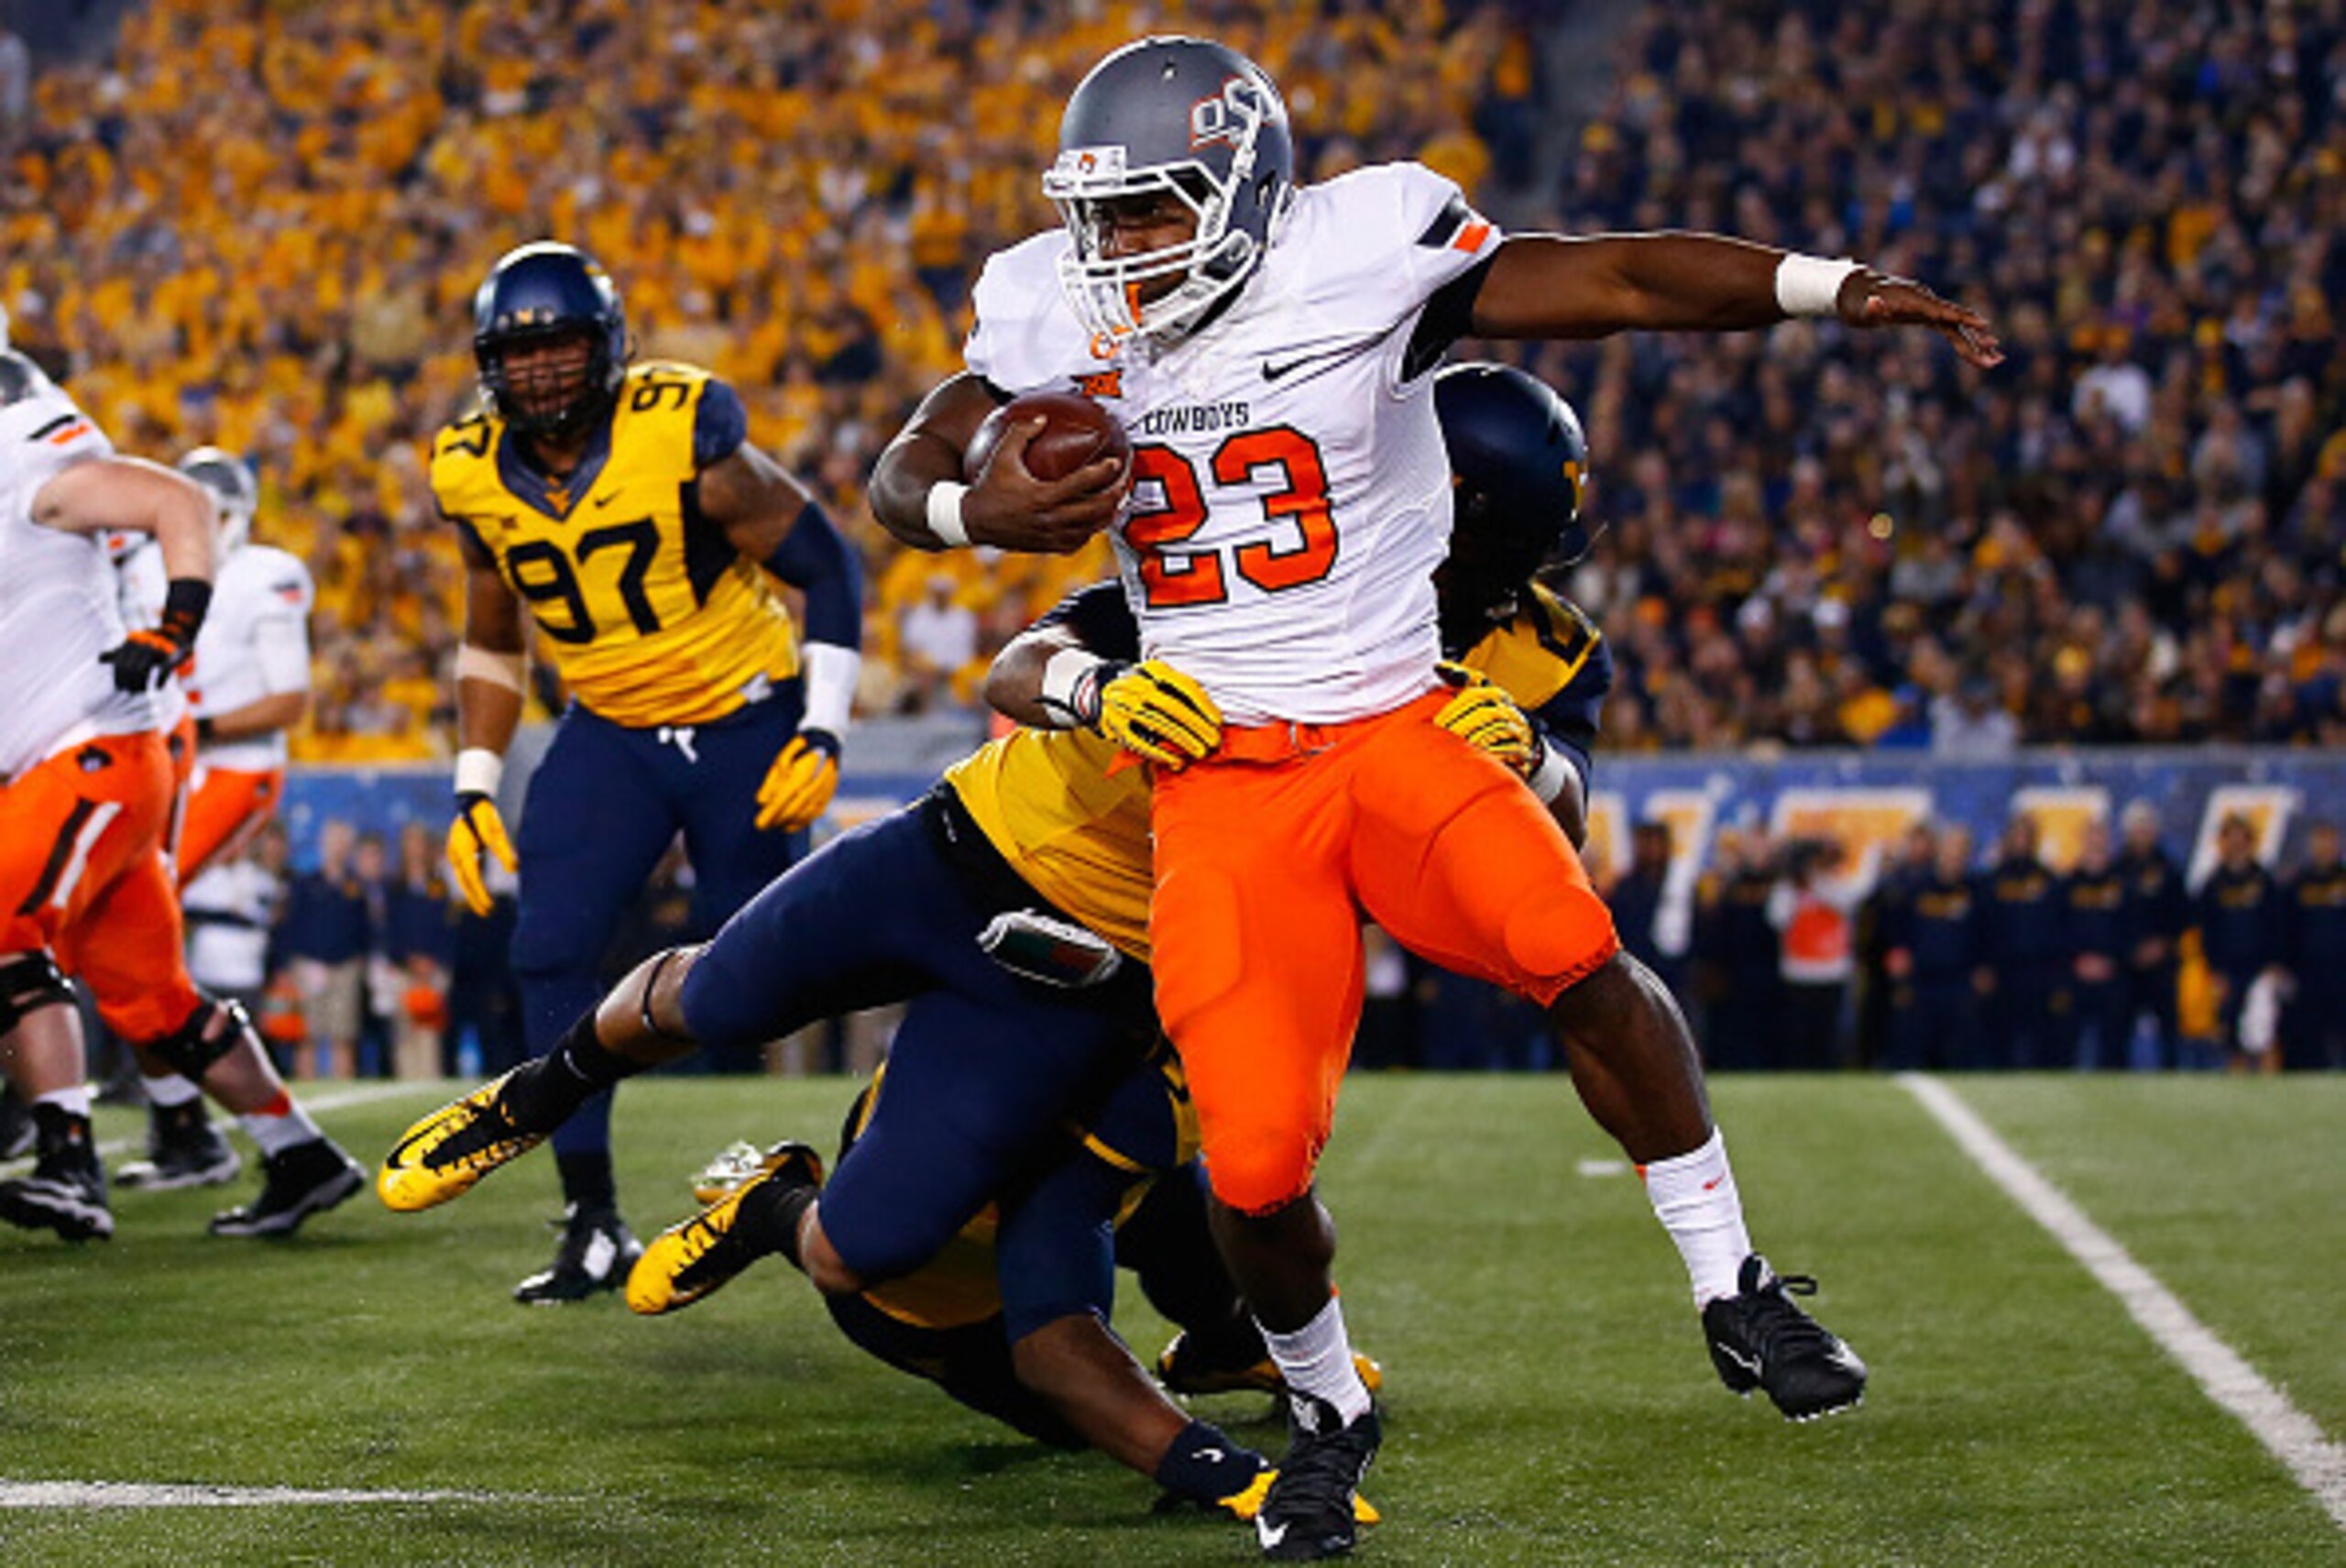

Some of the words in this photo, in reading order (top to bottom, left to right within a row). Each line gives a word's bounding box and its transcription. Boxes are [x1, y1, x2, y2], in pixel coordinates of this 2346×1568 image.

[1145, 401, 1250, 435] COWBOYS
[1121, 422, 1340, 611] 23
[506, 517, 662, 644] 97
